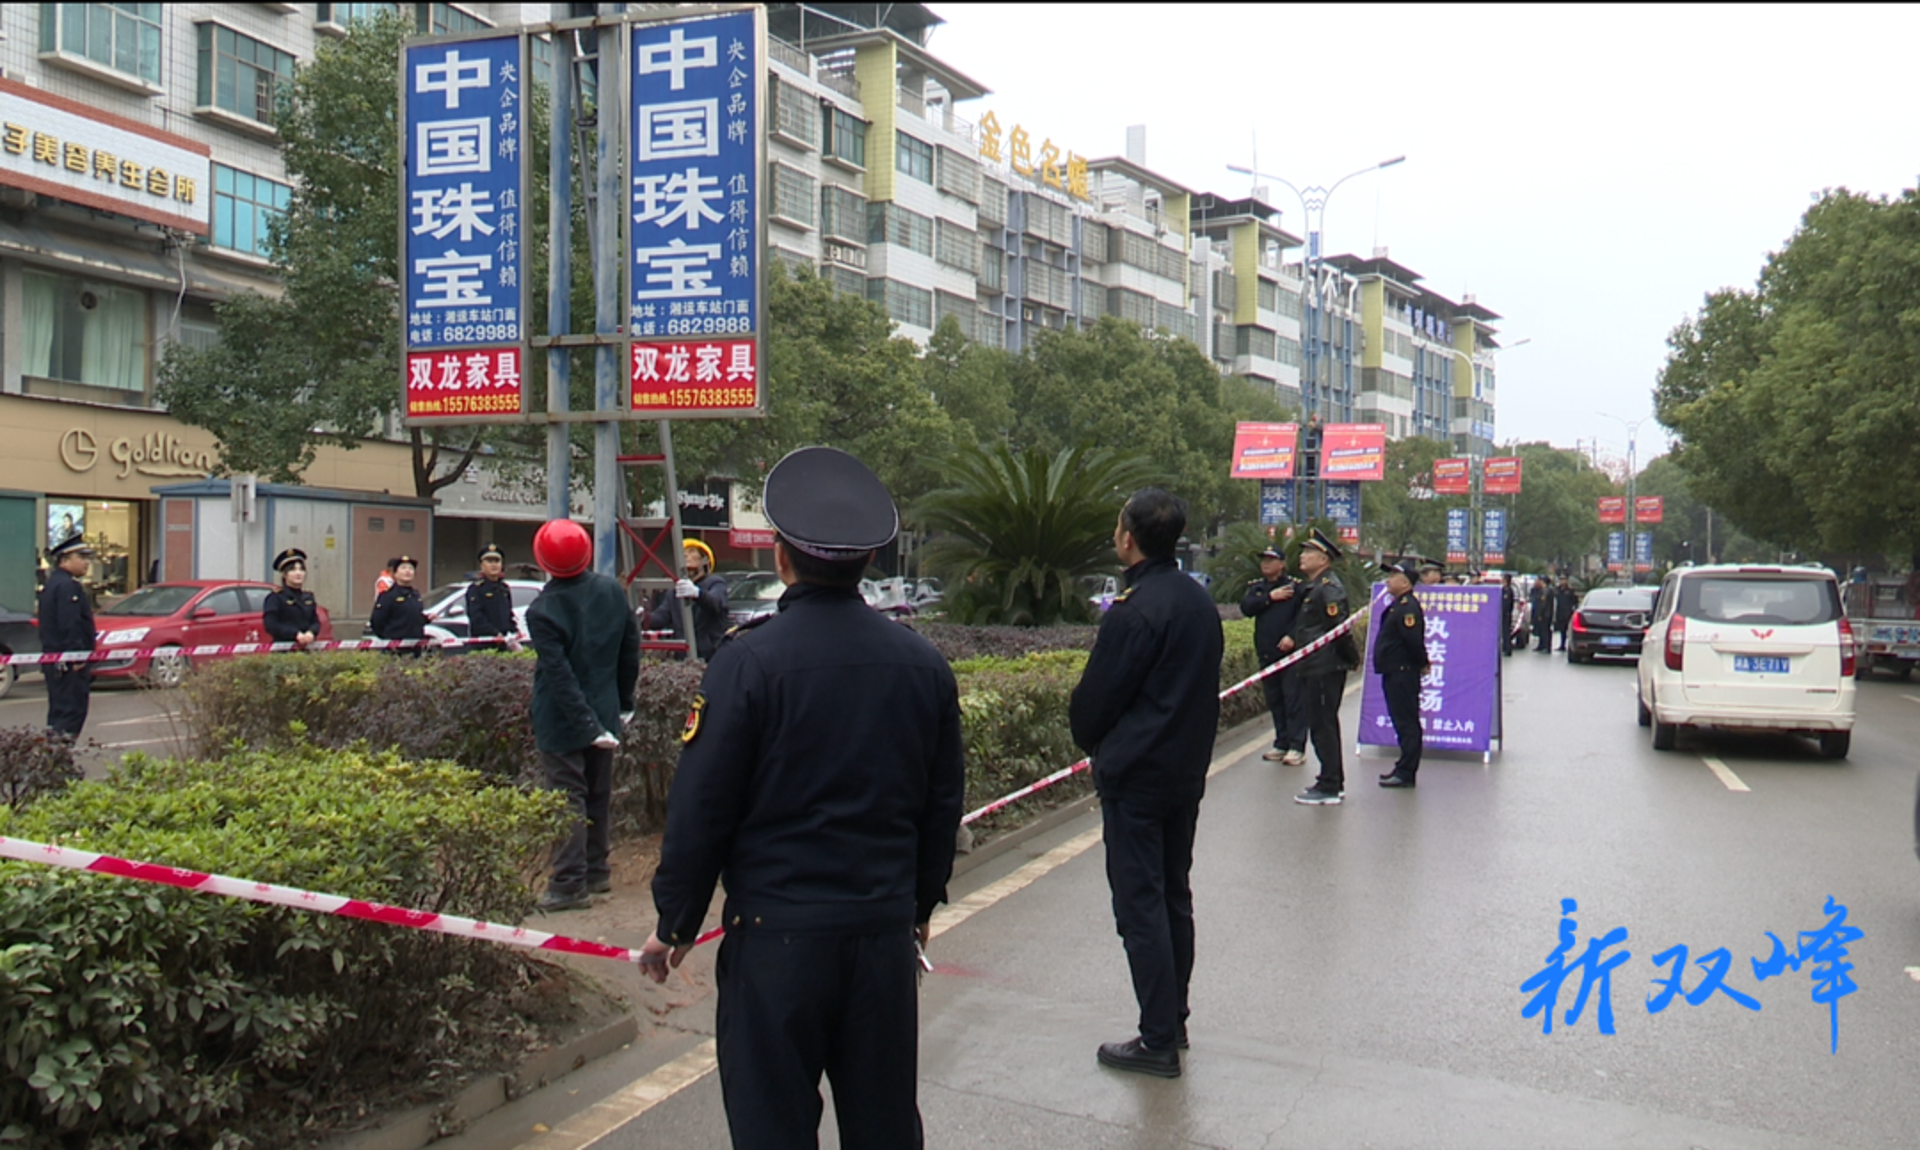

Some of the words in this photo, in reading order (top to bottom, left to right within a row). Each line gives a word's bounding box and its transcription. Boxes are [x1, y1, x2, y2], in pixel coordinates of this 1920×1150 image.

[499, 60, 518, 163] 央企品牌
[727, 37, 748, 146] 央企品牌
[412, 50, 496, 309] 中国珠宝
[633, 28, 725, 300] 中国珠宝
[497, 188, 518, 288] 值得信赖
[727, 173, 749, 279] 值得信赖
[409, 352, 520, 390] 双龙家具
[632, 344, 755, 383] 双龙家具
